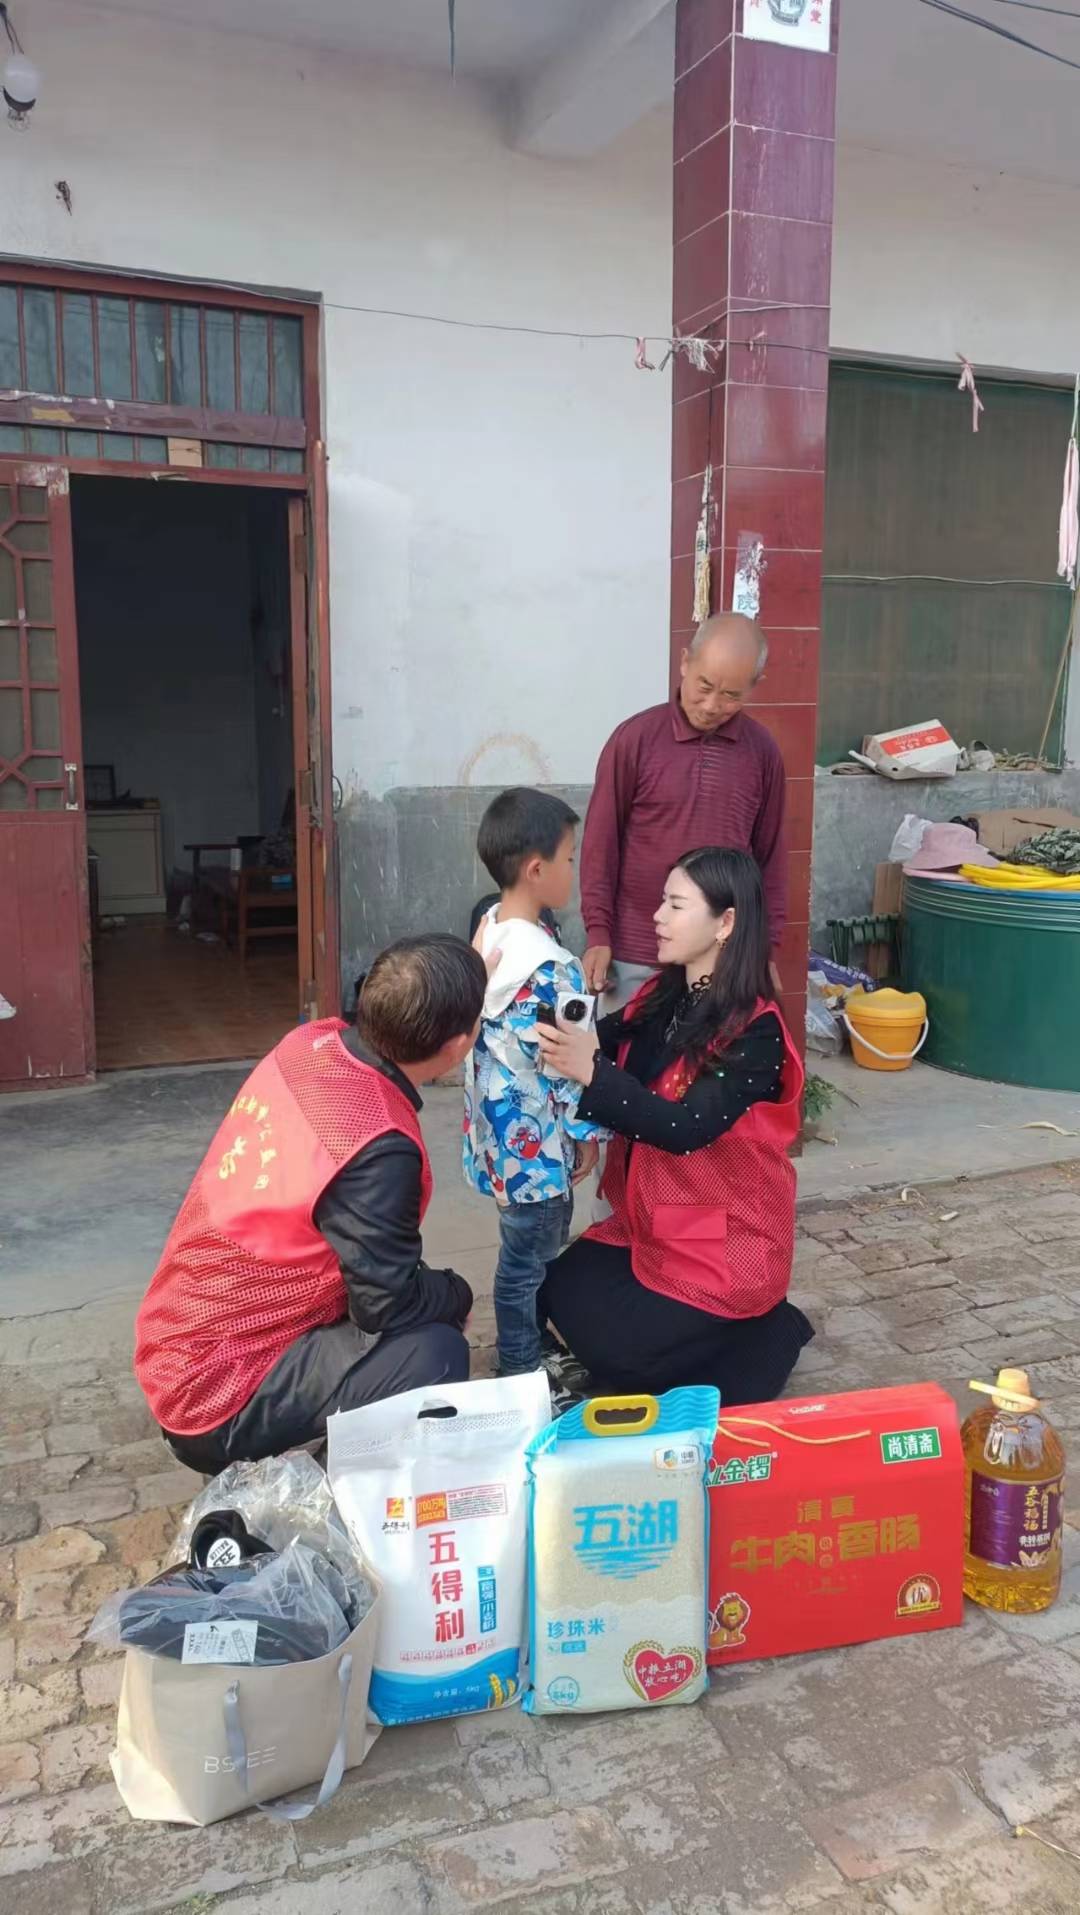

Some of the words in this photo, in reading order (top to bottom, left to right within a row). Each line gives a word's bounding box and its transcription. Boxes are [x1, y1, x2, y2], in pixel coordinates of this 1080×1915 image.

[888, 1433, 933, 1459] 尚清斋
[573, 1500, 678, 1550] 五湖
[428, 1530, 465, 1643] 五得利
[547, 1618, 606, 1639] 珍珠米
